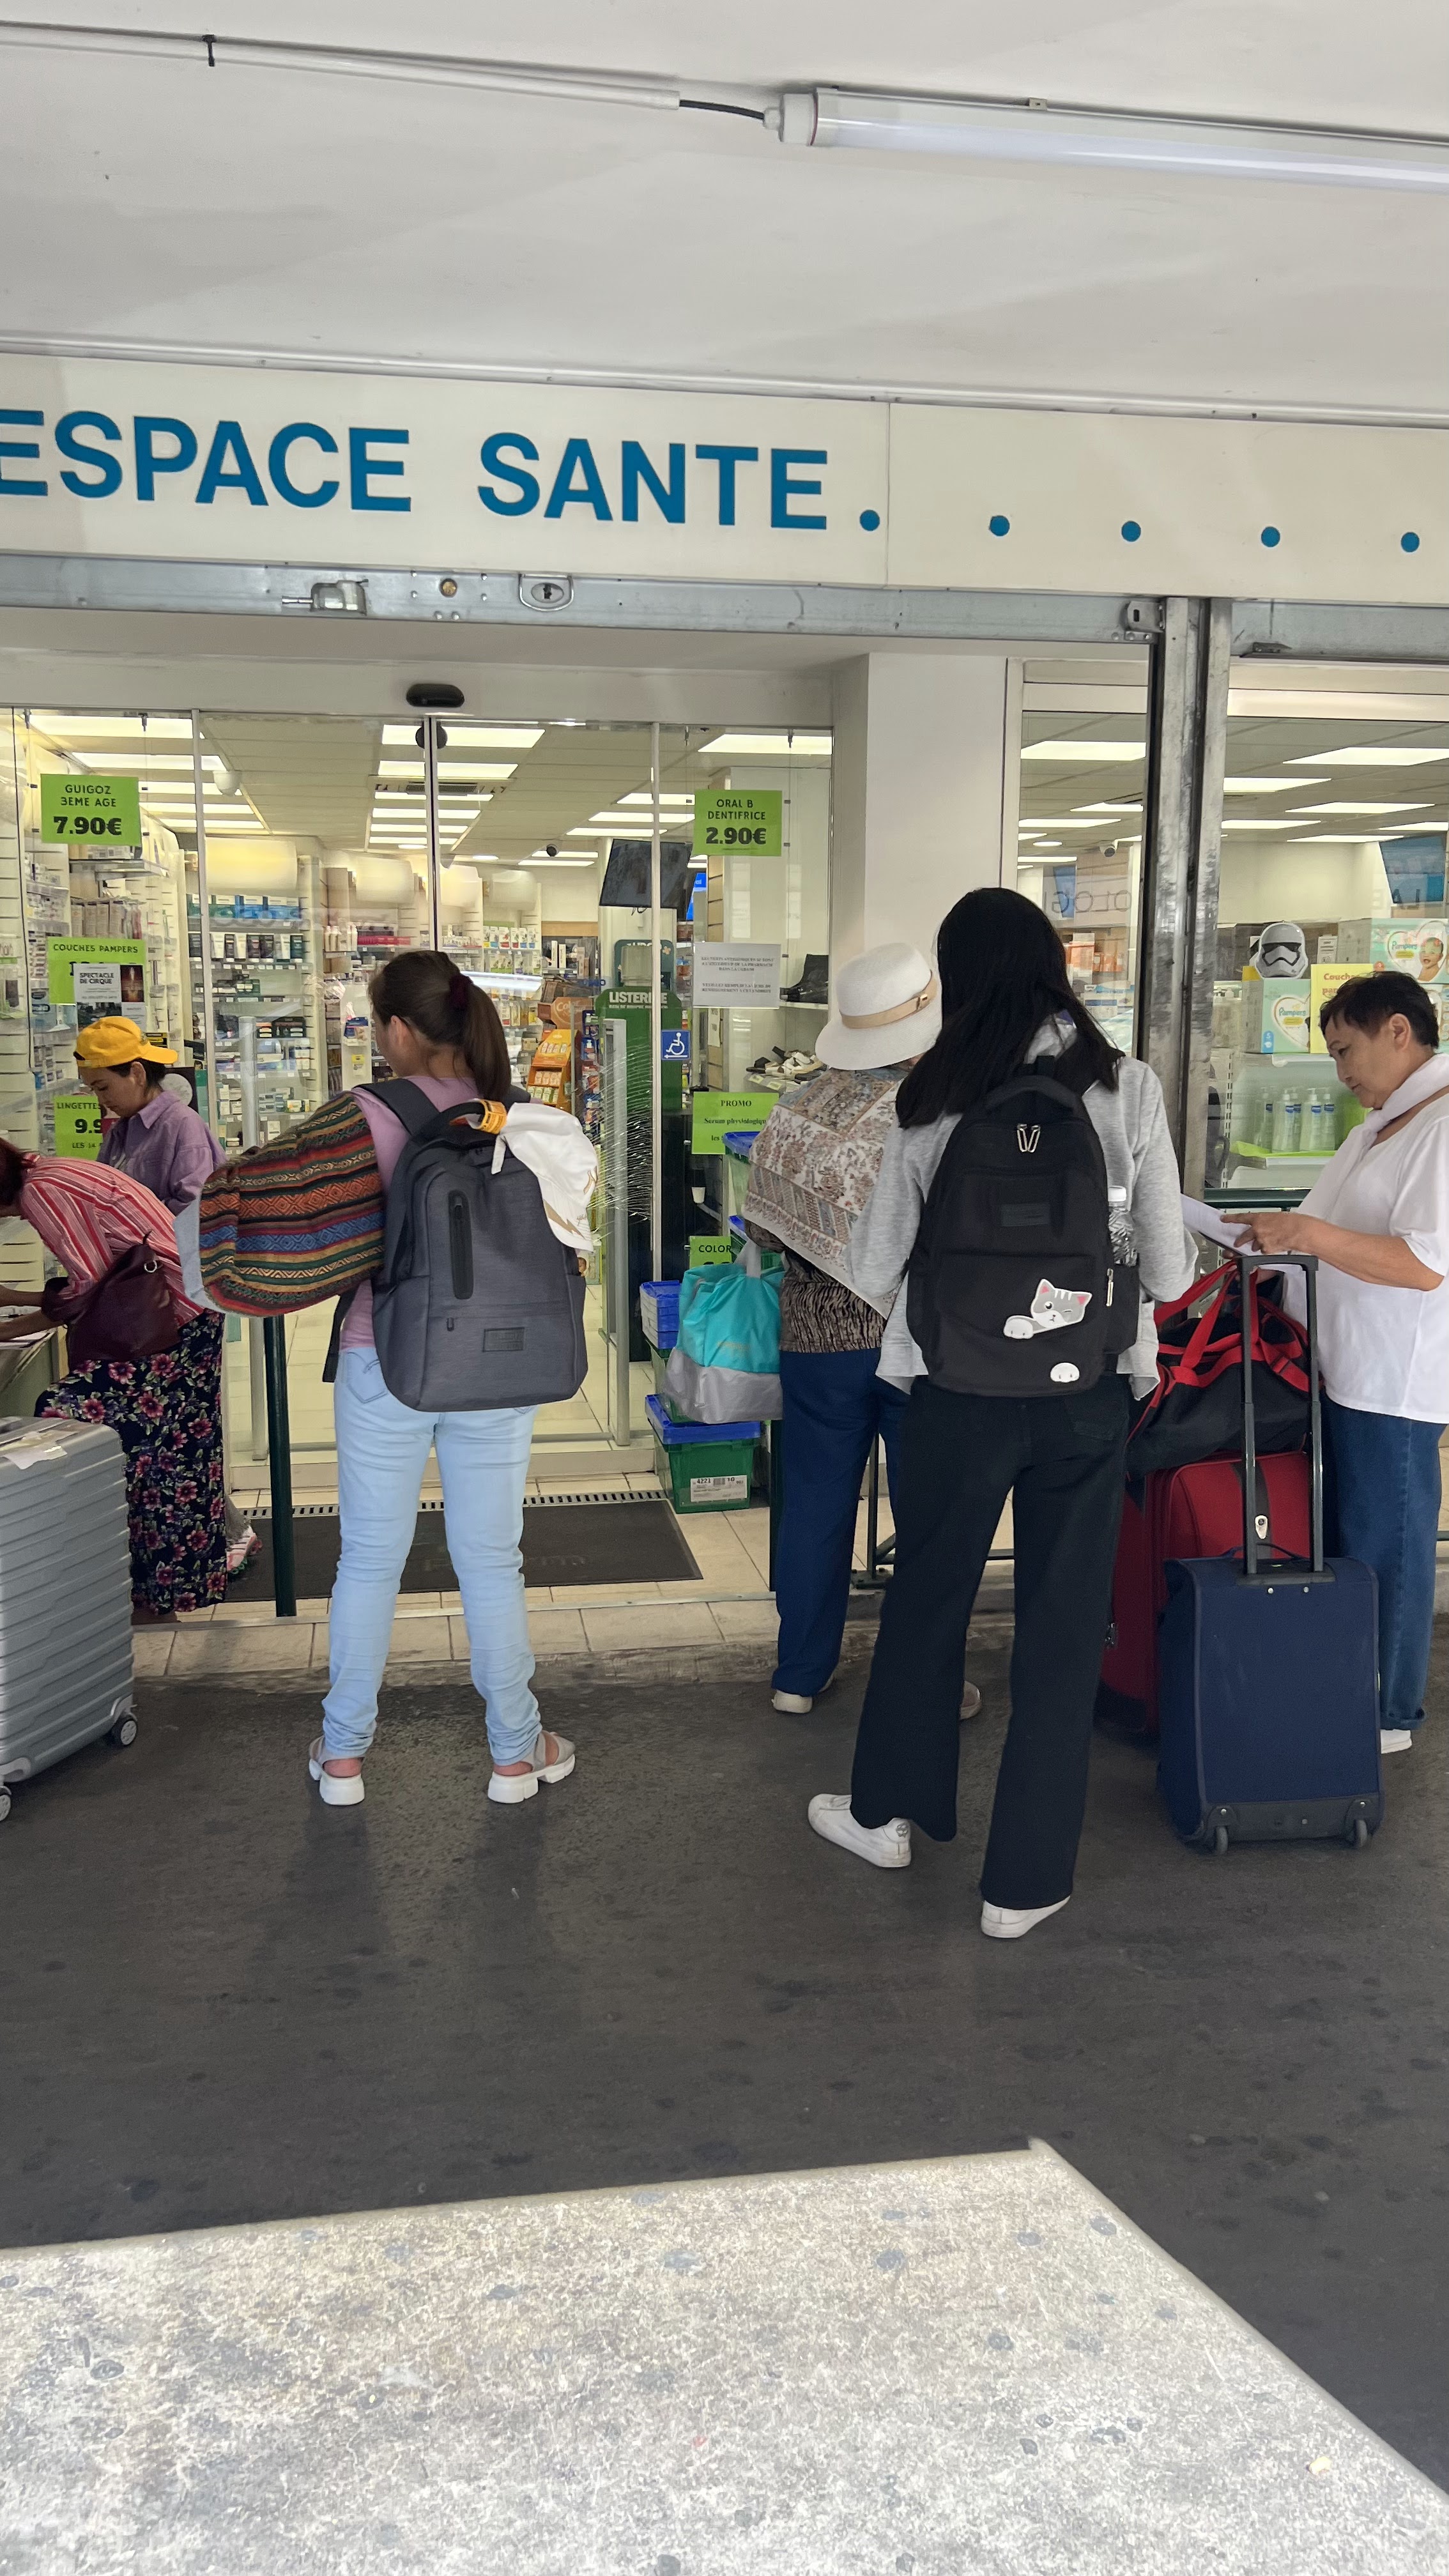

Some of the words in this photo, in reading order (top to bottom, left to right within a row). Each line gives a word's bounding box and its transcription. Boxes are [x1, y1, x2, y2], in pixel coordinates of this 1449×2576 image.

[0, 409, 411, 512] ESPACE
[65, 784, 112, 795] GUIGOZ
[61, 797, 89, 806] 3EME
[95, 798, 116, 807] AGE
[716, 799, 743, 808] ORAL
[747, 799, 753, 808] B
[707, 811, 766, 820] DENTIFRICE
[53, 816, 122, 836] 7.90€
[705, 827, 767, 845] 2.90€
[53, 944, 96, 952] COUCHES
[99, 945, 138, 953] PAMPERS
[609, 991, 668, 1004] LISTERIE
[1278, 1007, 1307, 1016] Pampers
